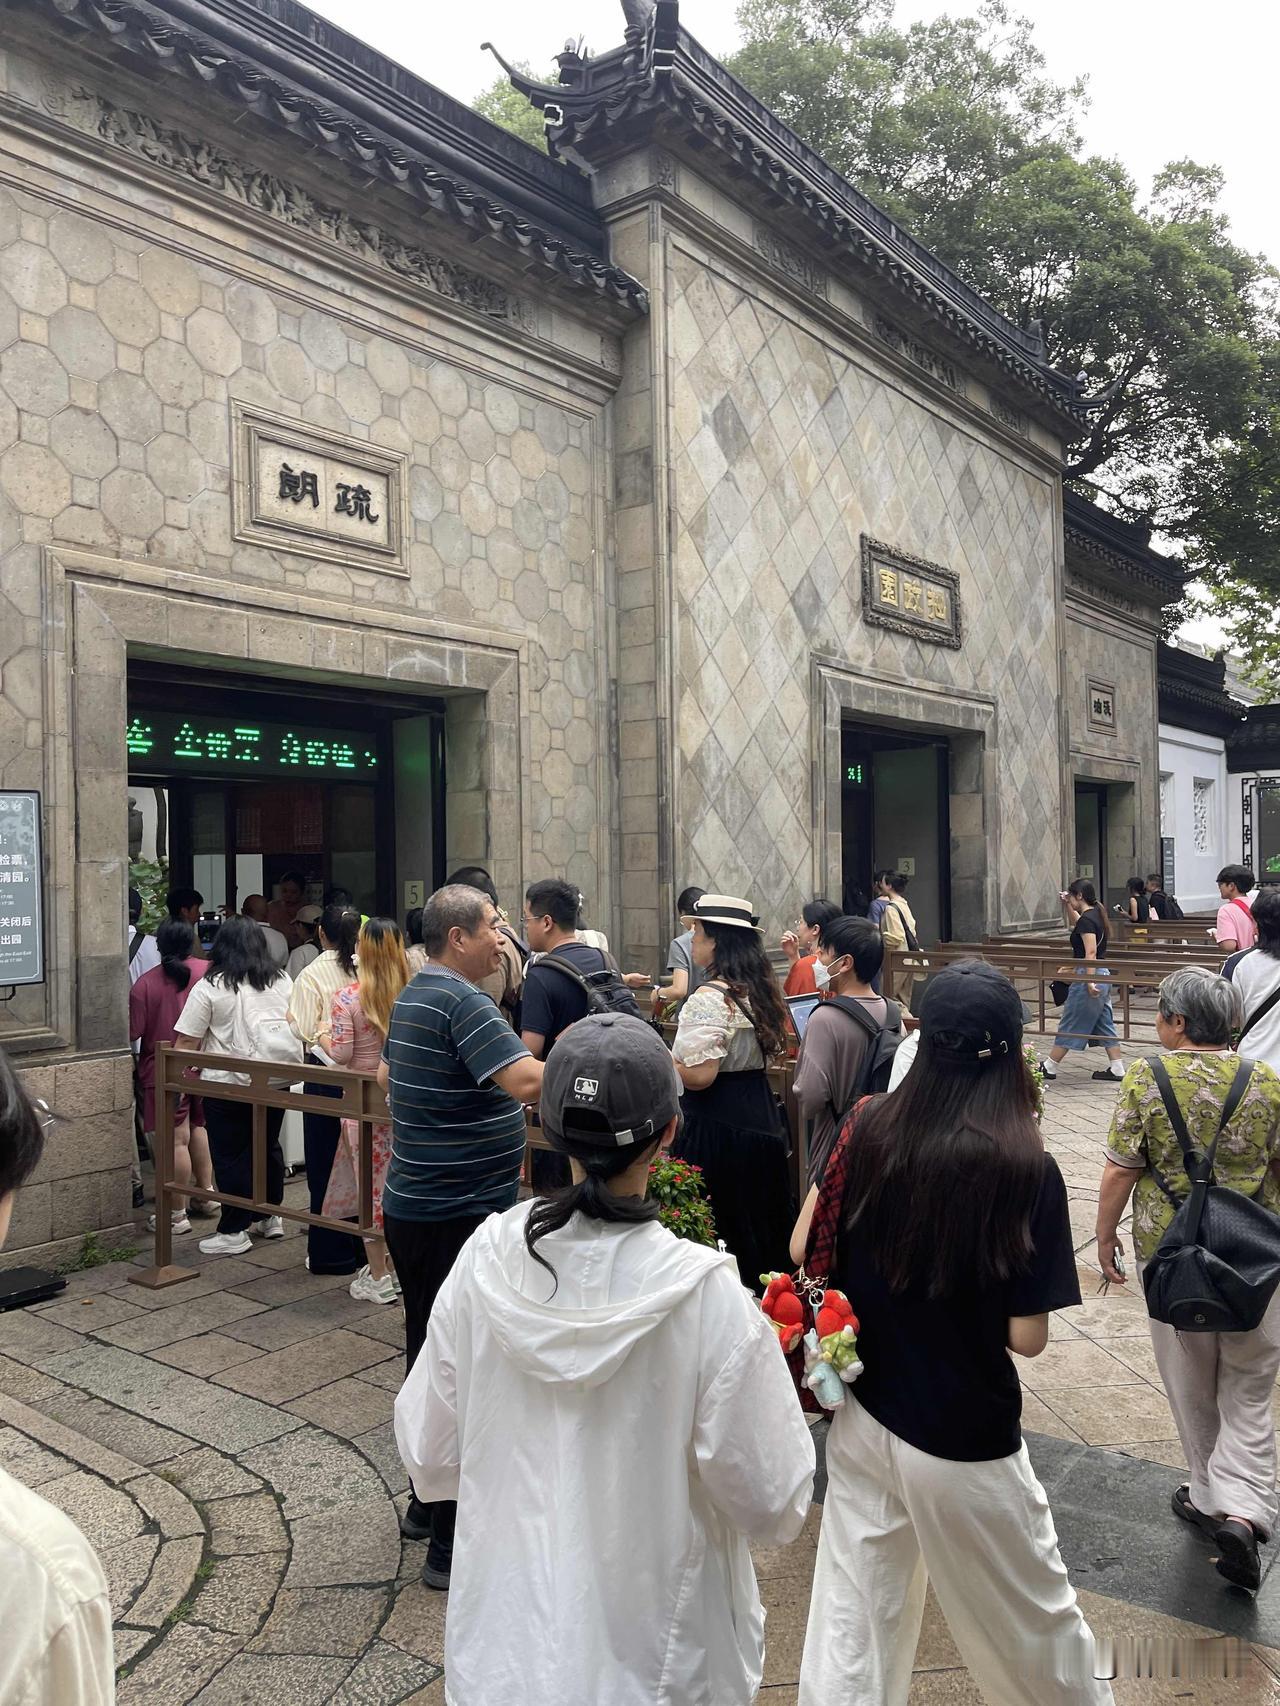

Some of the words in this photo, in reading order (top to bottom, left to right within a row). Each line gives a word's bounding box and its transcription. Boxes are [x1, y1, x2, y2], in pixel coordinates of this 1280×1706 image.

[903, 860, 910, 873] 3
[410, 885, 418, 905] 5
[1, 934, 22, 945] 出园
